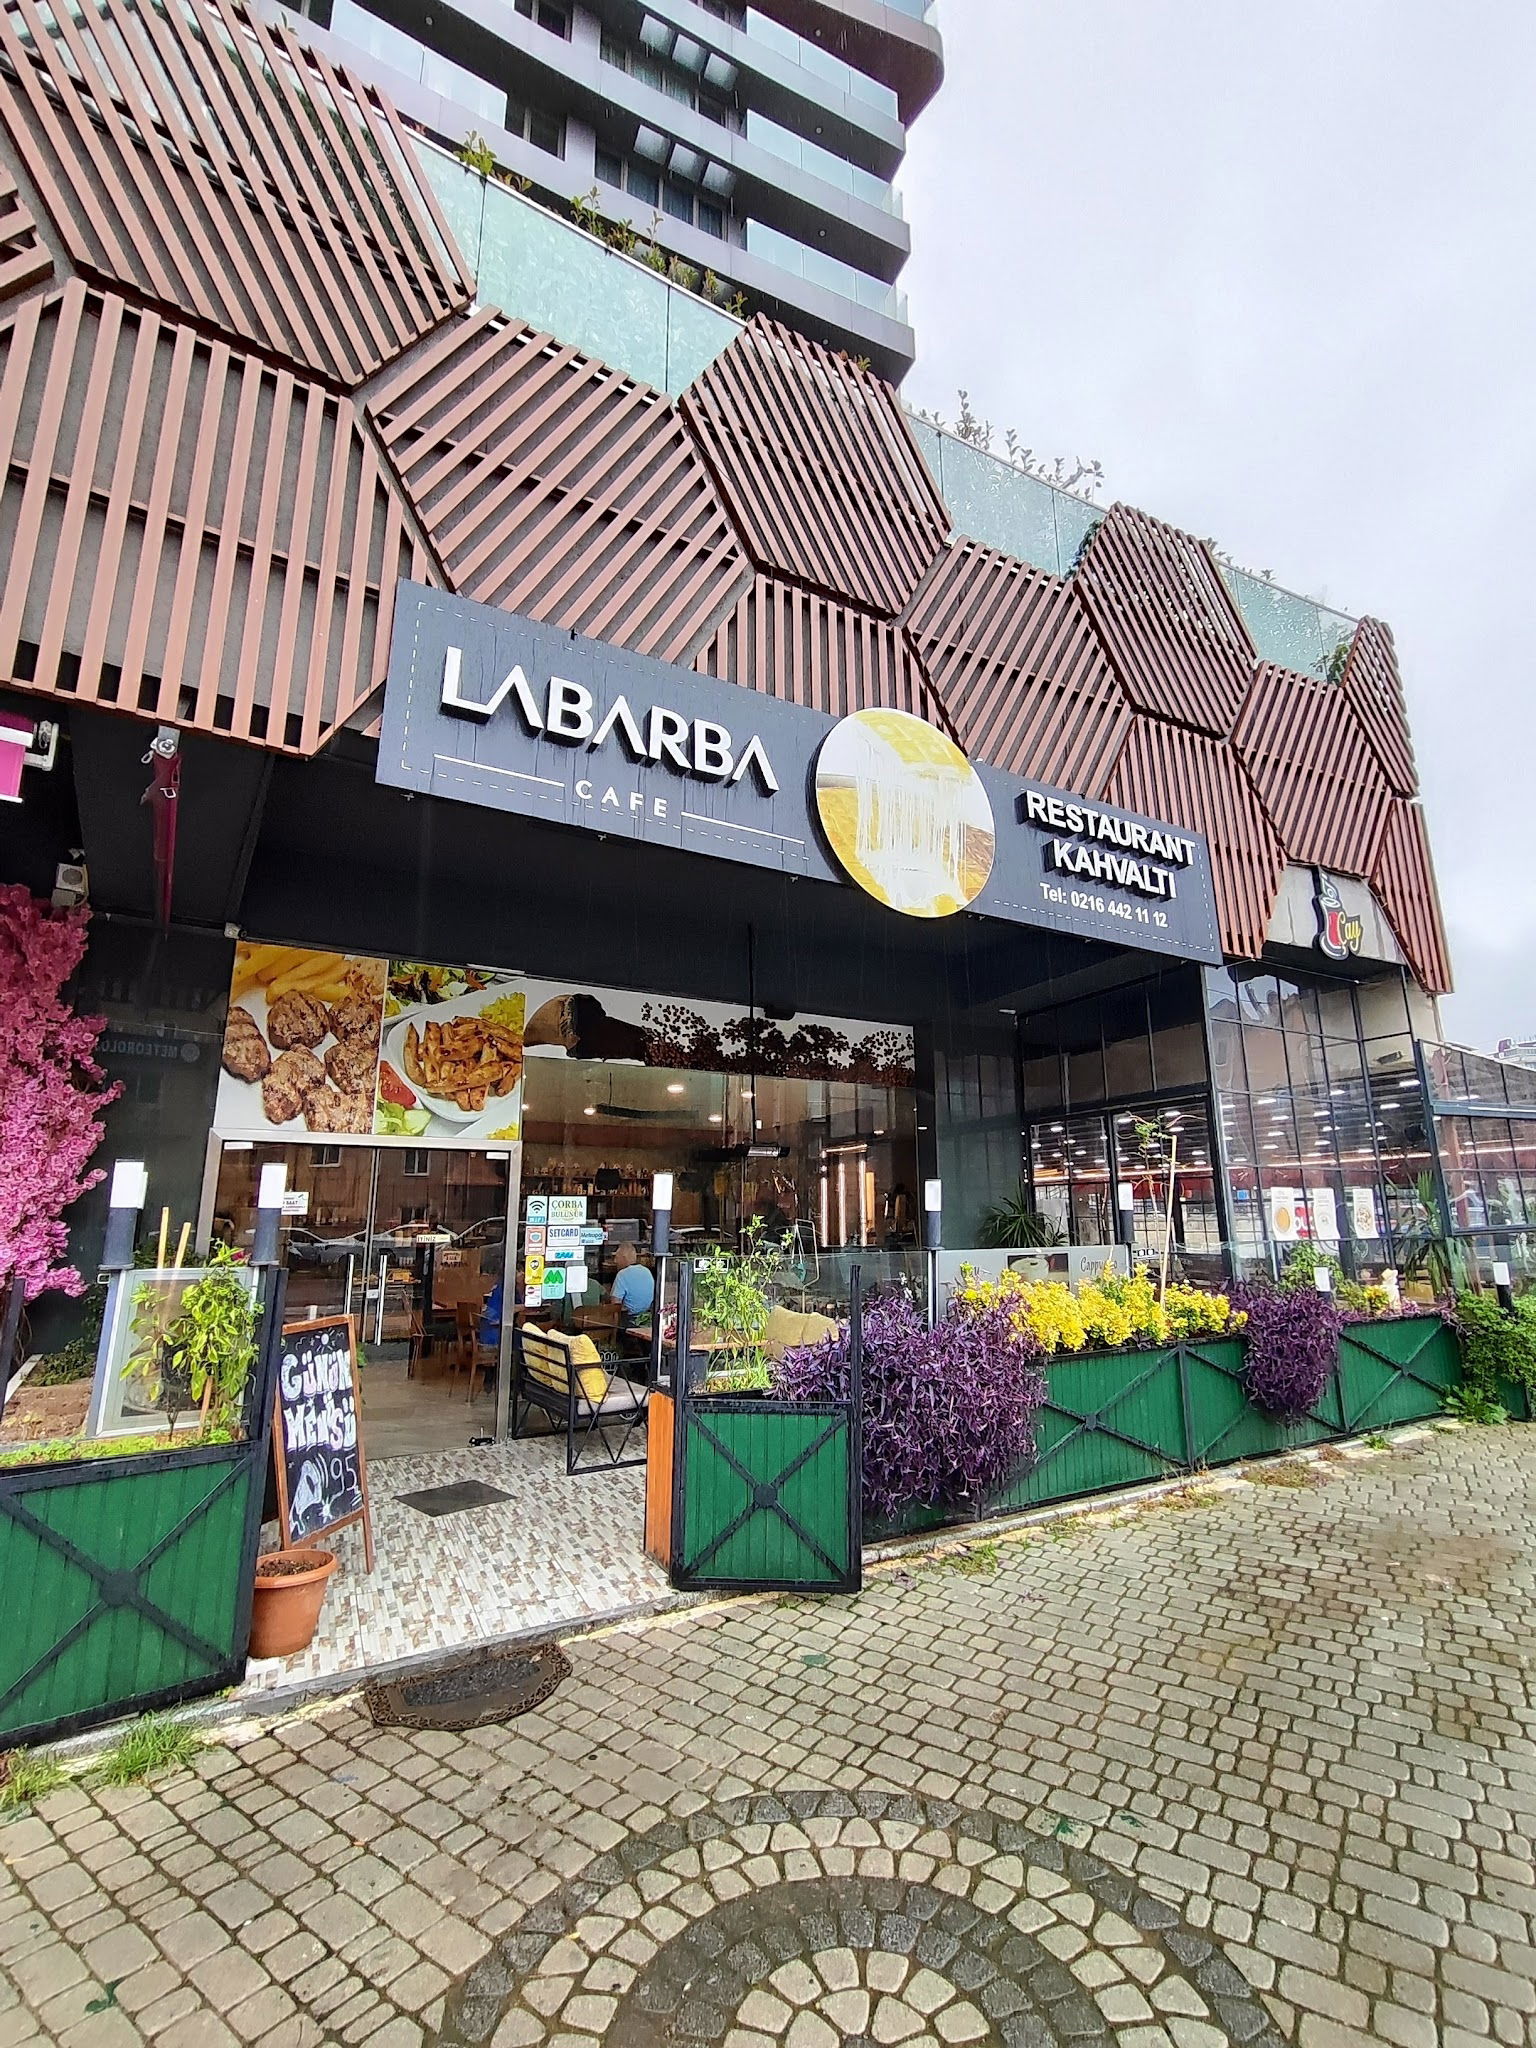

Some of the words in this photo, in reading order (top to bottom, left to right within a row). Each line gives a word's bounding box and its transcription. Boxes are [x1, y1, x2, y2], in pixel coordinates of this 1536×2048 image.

[441, 646, 779, 791] LABARBA
[576, 780, 667, 818] CAFE
[1026, 790, 1196, 865] RESTAURANT
[1053, 839, 1177, 898] KAHVALTI
[1040, 882, 1067, 904] Tel:
[1071, 890, 1104, 913] 0216
[1108, 900, 1133, 919] 442
[1135, 906, 1149, 923] 11
[1153, 912, 1168, 927] 12
[551, 1200, 583, 1210] ÇORBA
[549, 1228, 579, 1237] SETCARD
[280, 1349, 353, 1401] GÜNÜN
